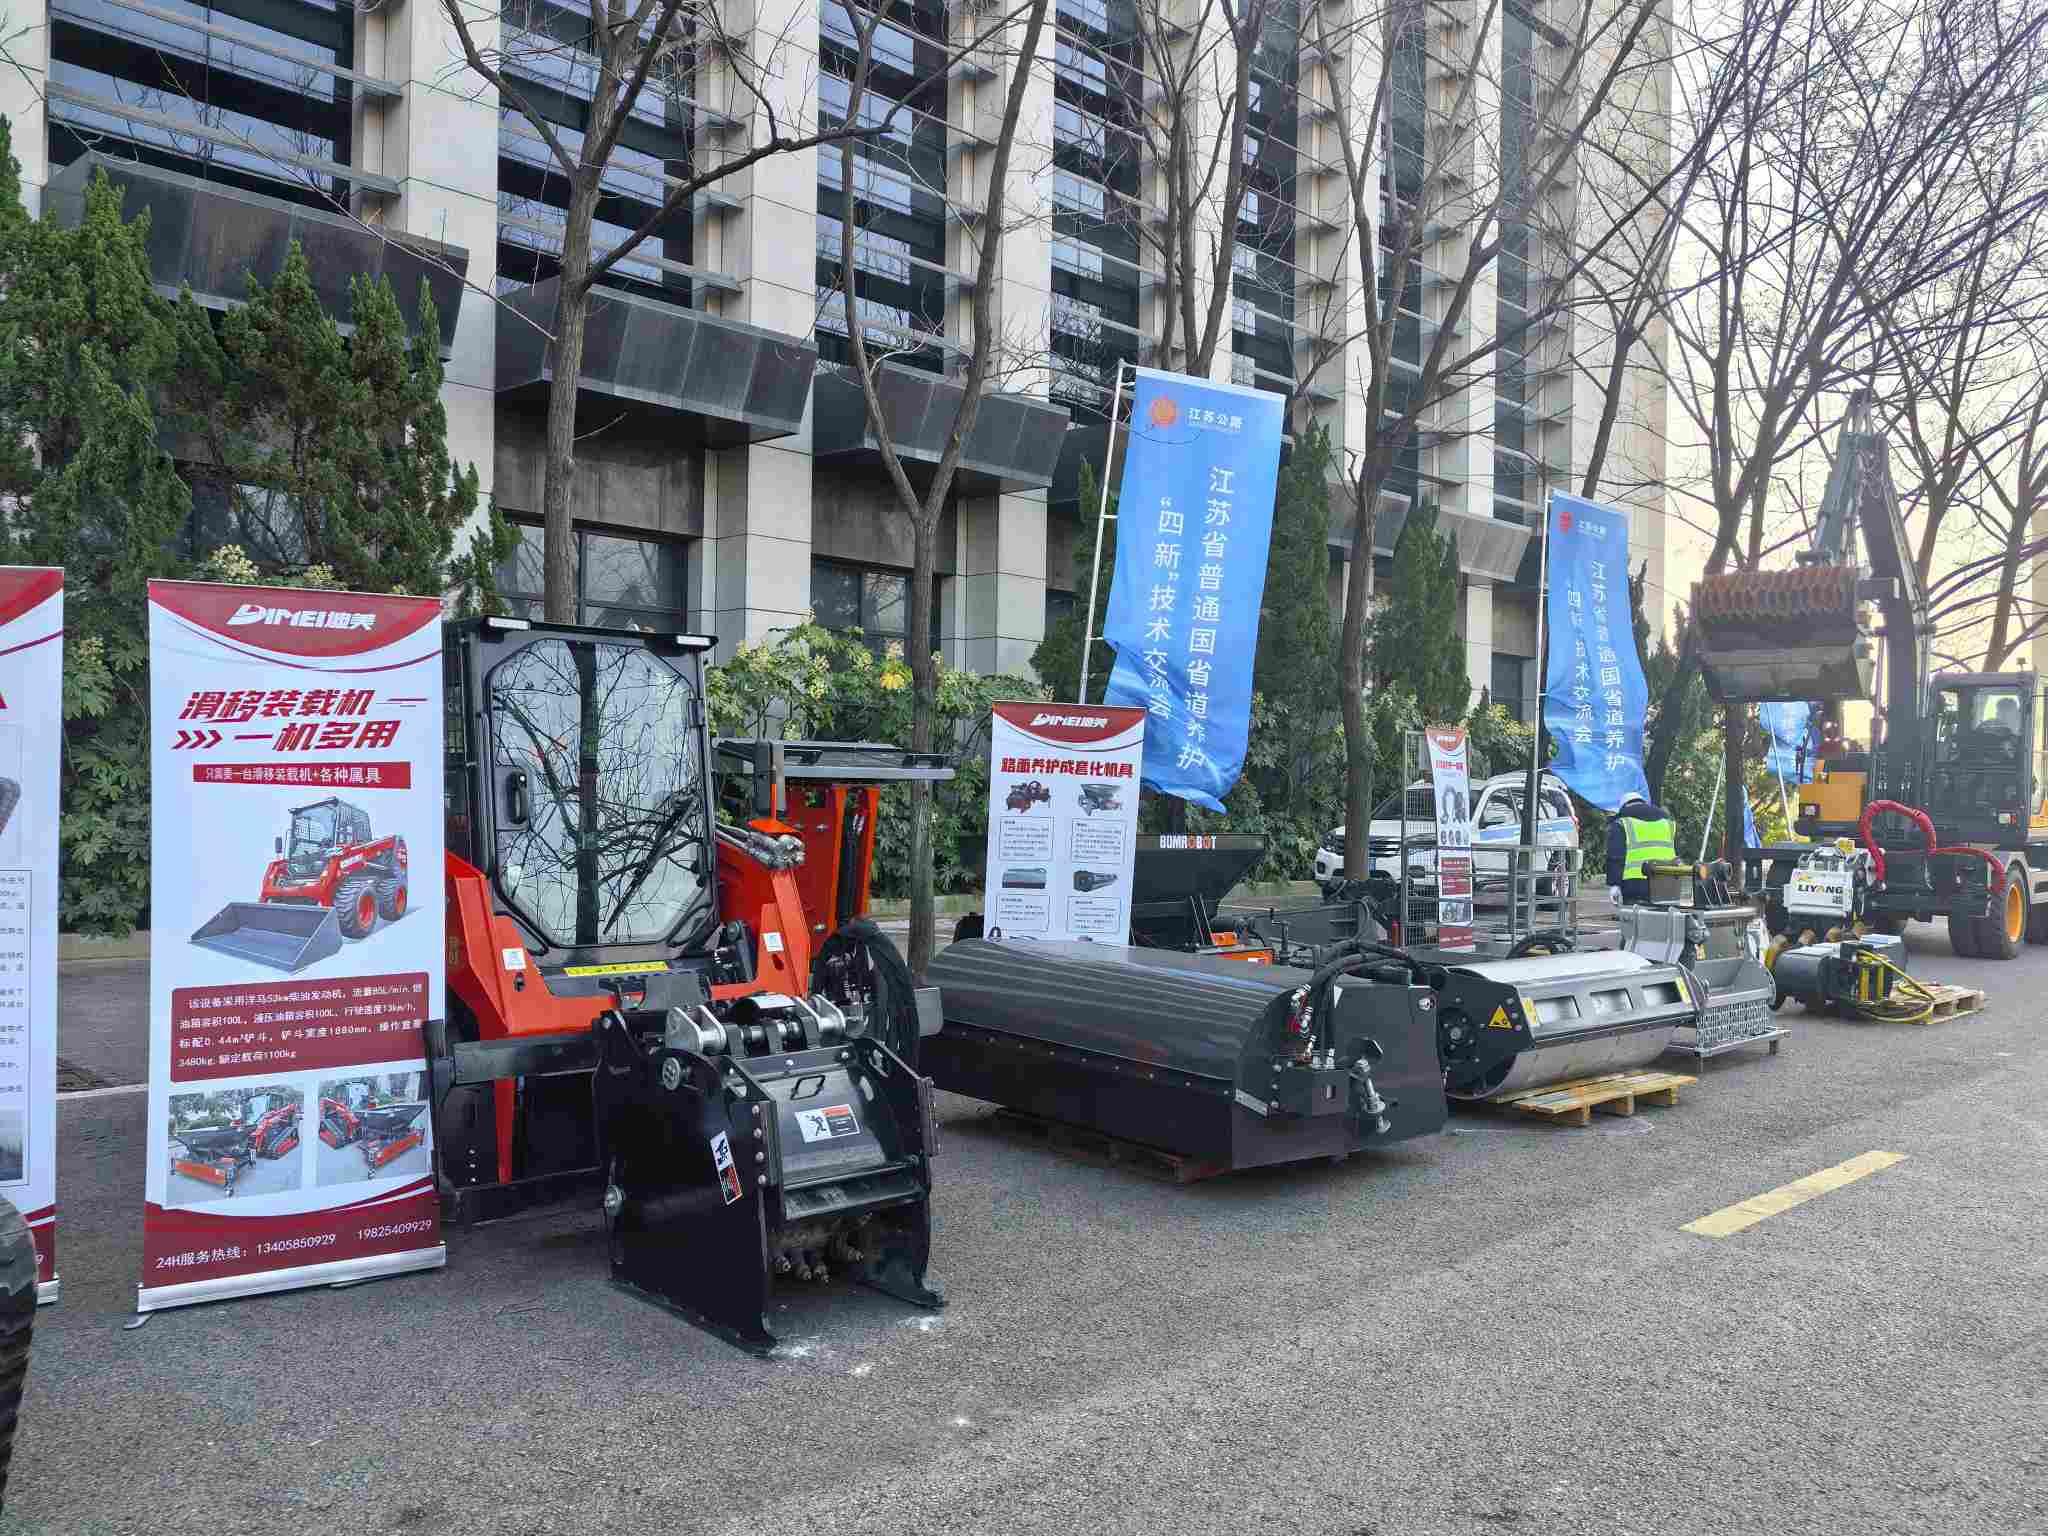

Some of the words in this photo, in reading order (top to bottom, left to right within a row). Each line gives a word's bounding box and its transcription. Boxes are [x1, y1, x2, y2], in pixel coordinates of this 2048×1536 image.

[1188, 407, 1243, 430] 江苏公路
[1176, 466, 1235, 770] 江苏省普通国省道养护
[178, 689, 376, 723] 滑移装载机
[234, 719, 401, 752] 一机多用
[1000, 757, 1133, 778] 路面养护成套化机具
[1160, 834, 1217, 849] BOMROBOT
[1798, 884, 1844, 894] LIYANG
[357, 1219, 432, 1240] 19825409929
